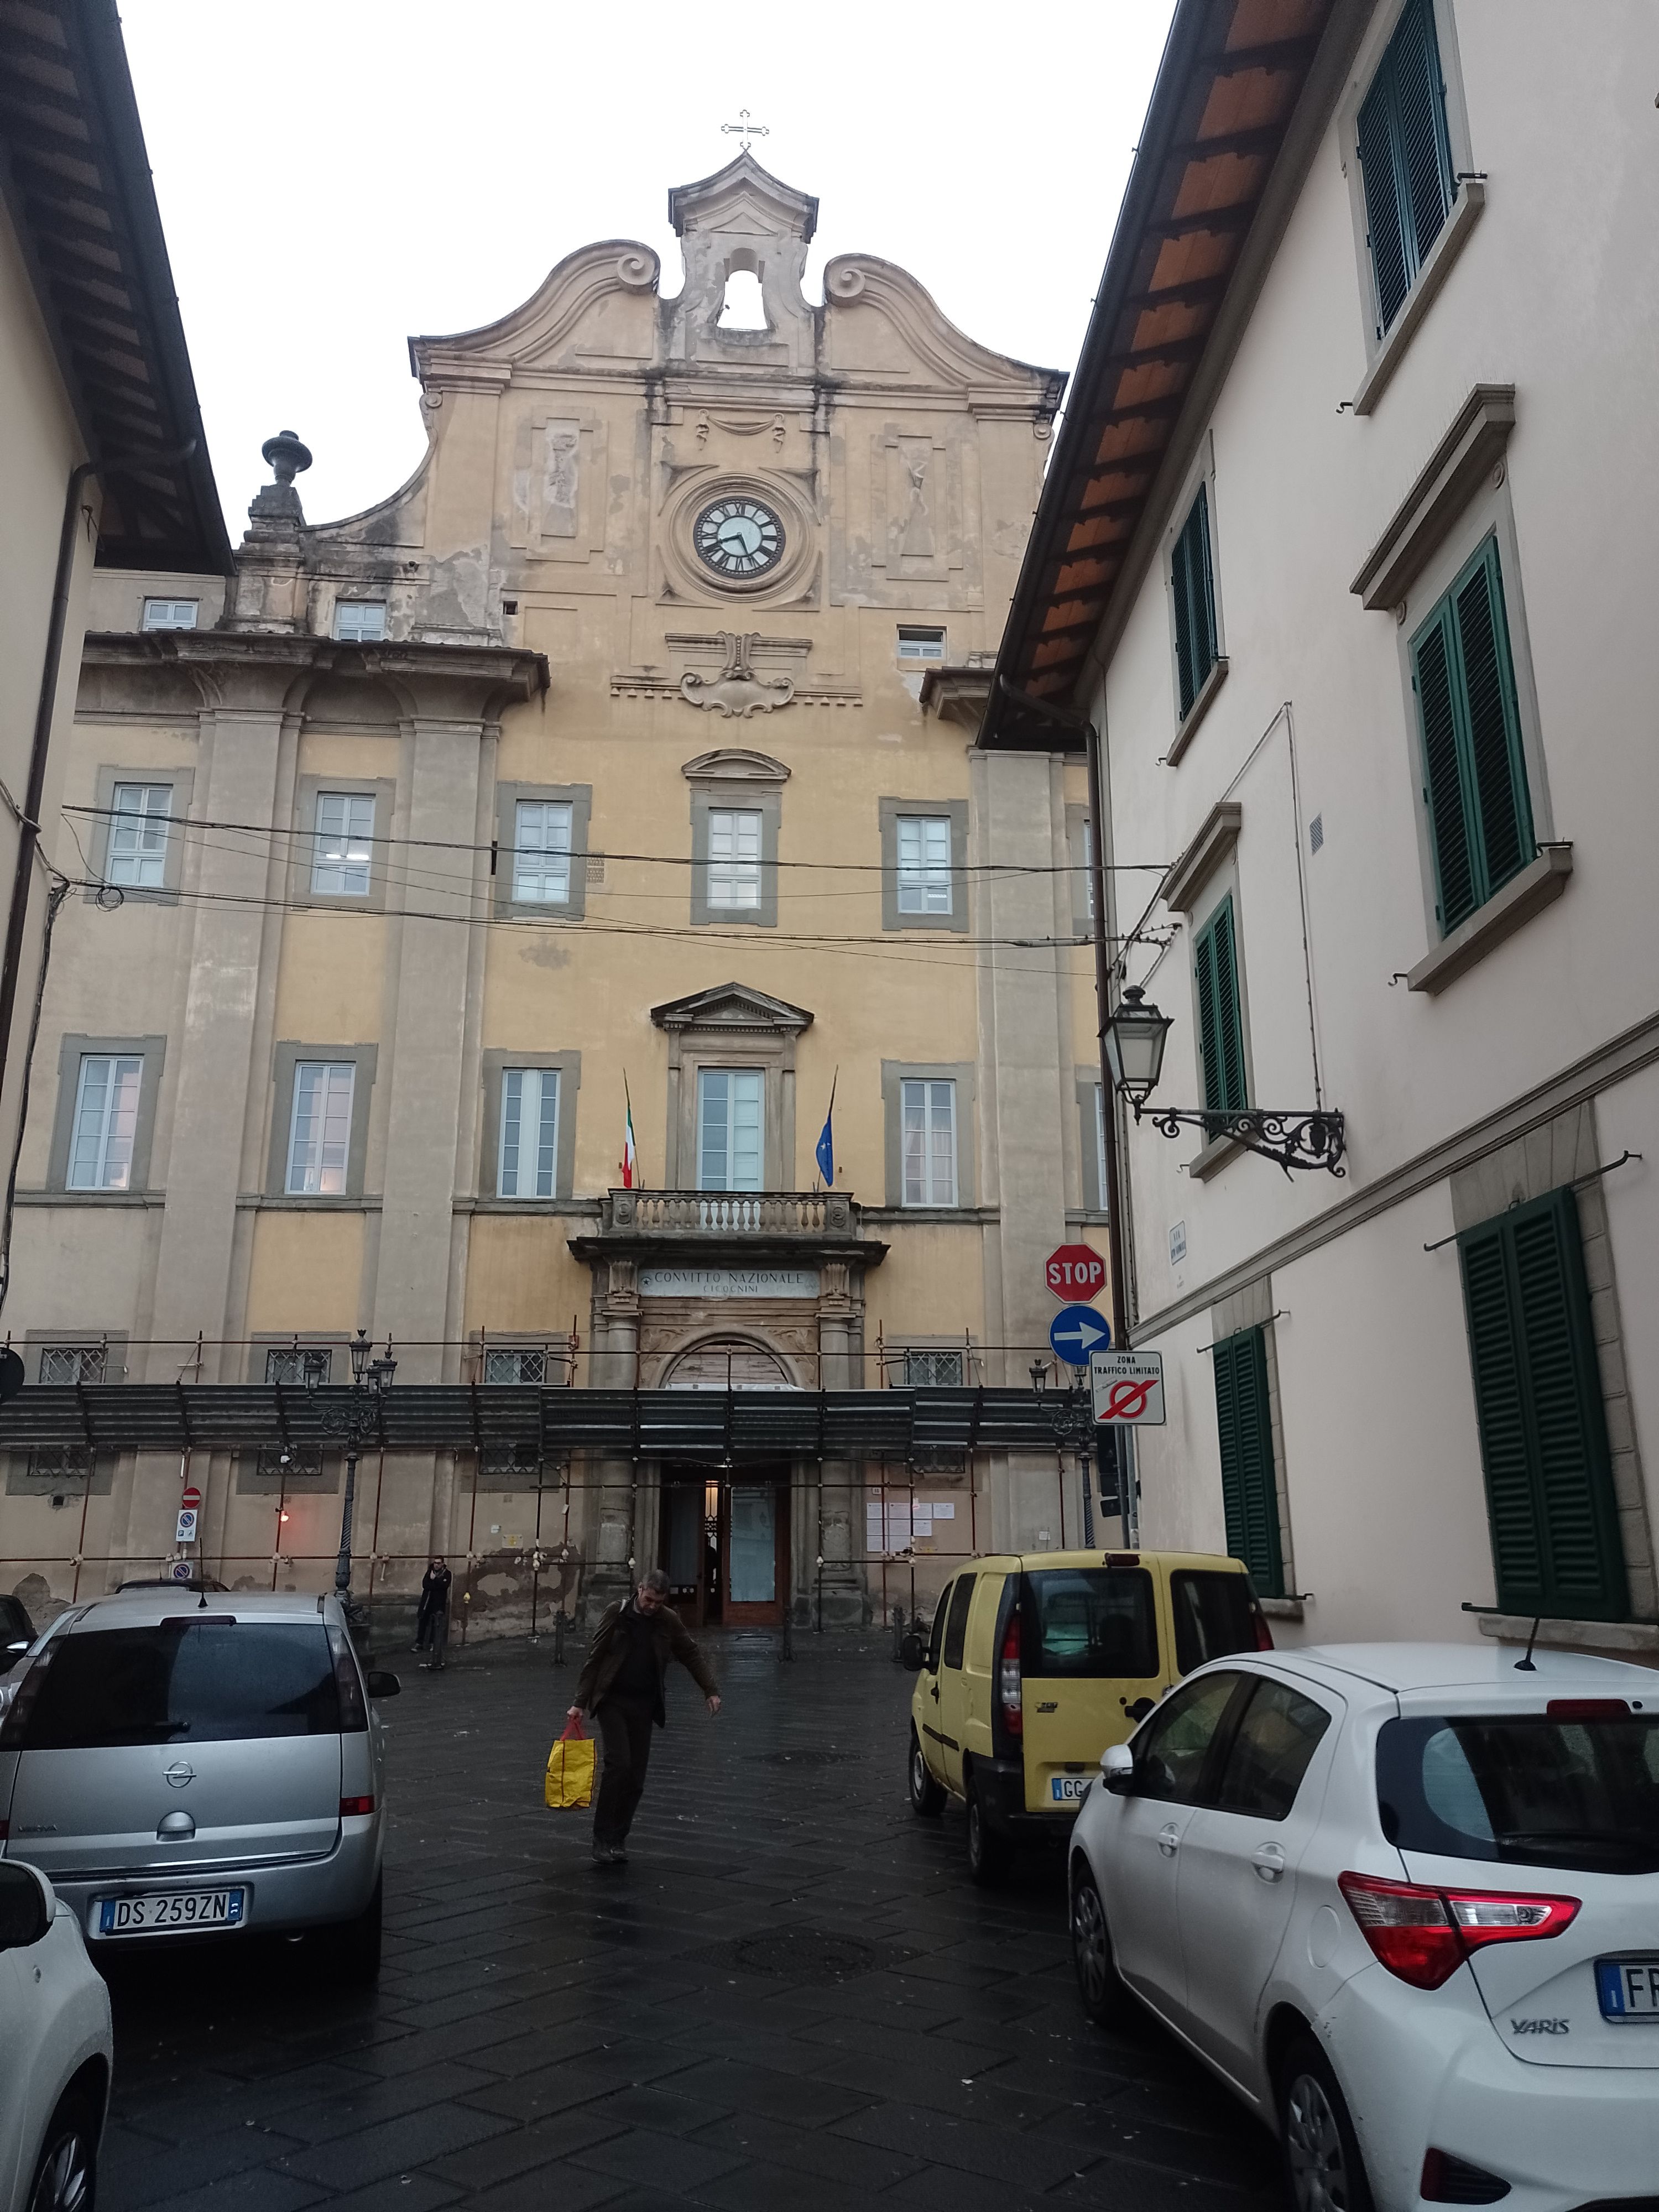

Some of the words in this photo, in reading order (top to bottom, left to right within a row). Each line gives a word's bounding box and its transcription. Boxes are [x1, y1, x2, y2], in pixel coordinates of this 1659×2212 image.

[655, 1272, 721, 1282] CONVITTO
[729, 1272, 804, 1284] NAZIONALE
[1048, 1261, 1102, 1285] STOP
[703, 1285, 758, 1293] CICOGNINI
[1129, 1366, 1160, 1375] LIMITATO
[117, 1901, 145, 1927] DS
[155, 1894, 227, 1923] 259ZN
